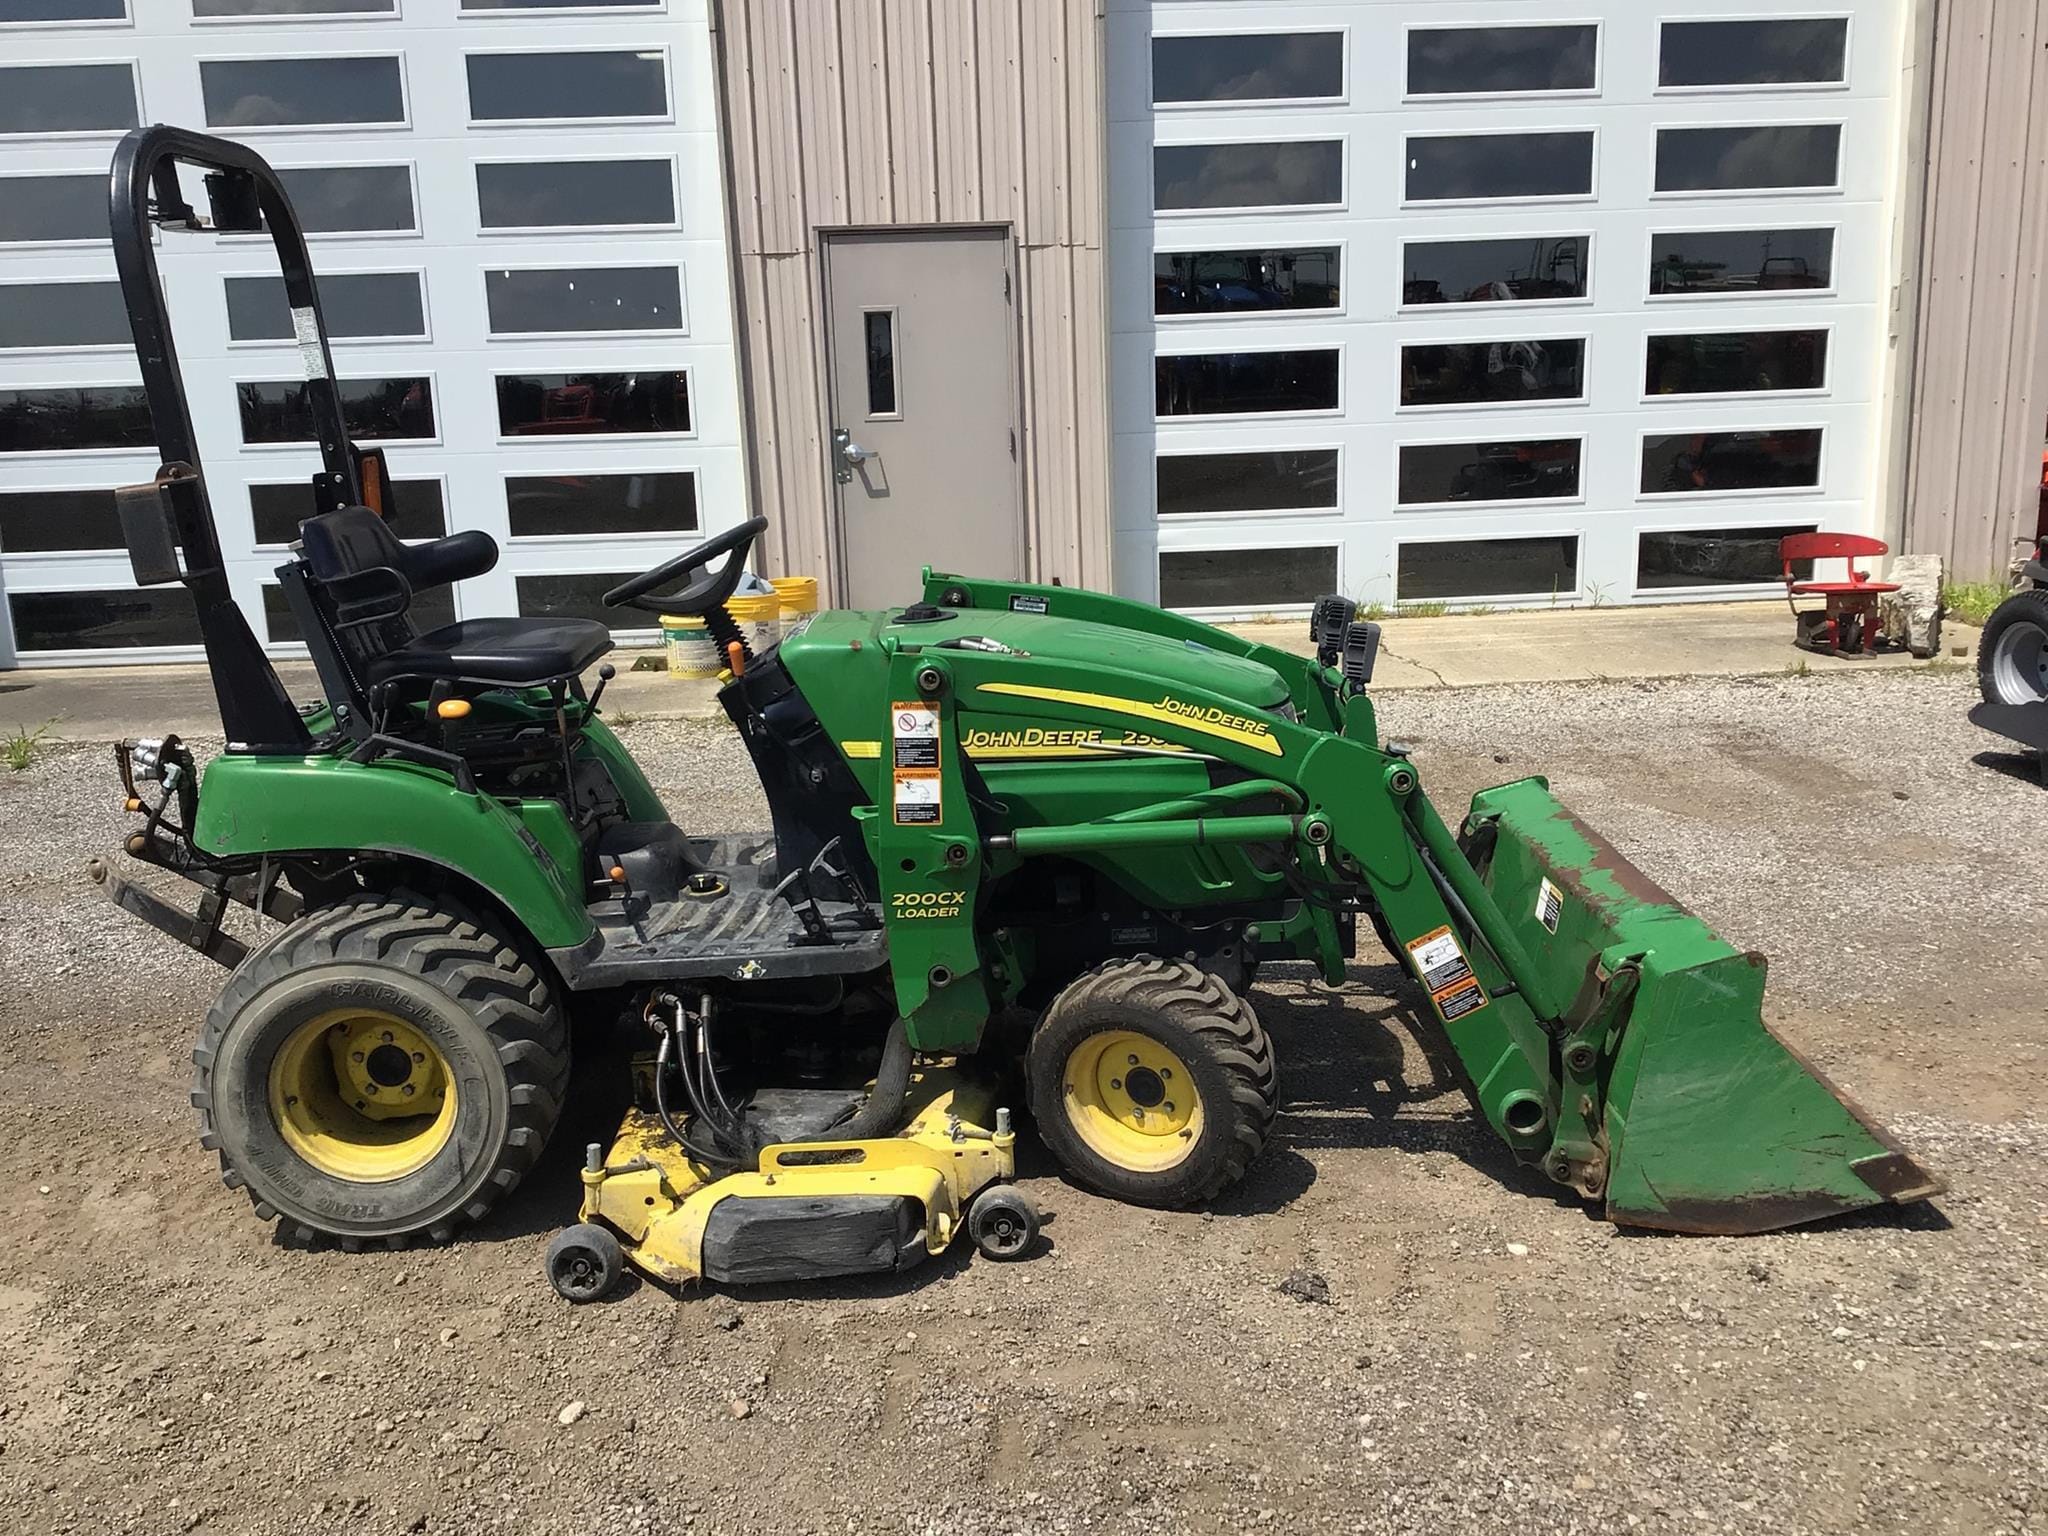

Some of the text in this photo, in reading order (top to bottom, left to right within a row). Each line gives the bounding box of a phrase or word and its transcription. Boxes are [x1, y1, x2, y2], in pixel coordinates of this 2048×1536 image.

[1153, 695, 1269, 735] JOHN DEERE
[960, 729, 1021, 746] JOHN
[1021, 728, 1102, 746] DEERE
[891, 891, 966, 906] 200CX
[896, 907, 959, 918] LOADER
